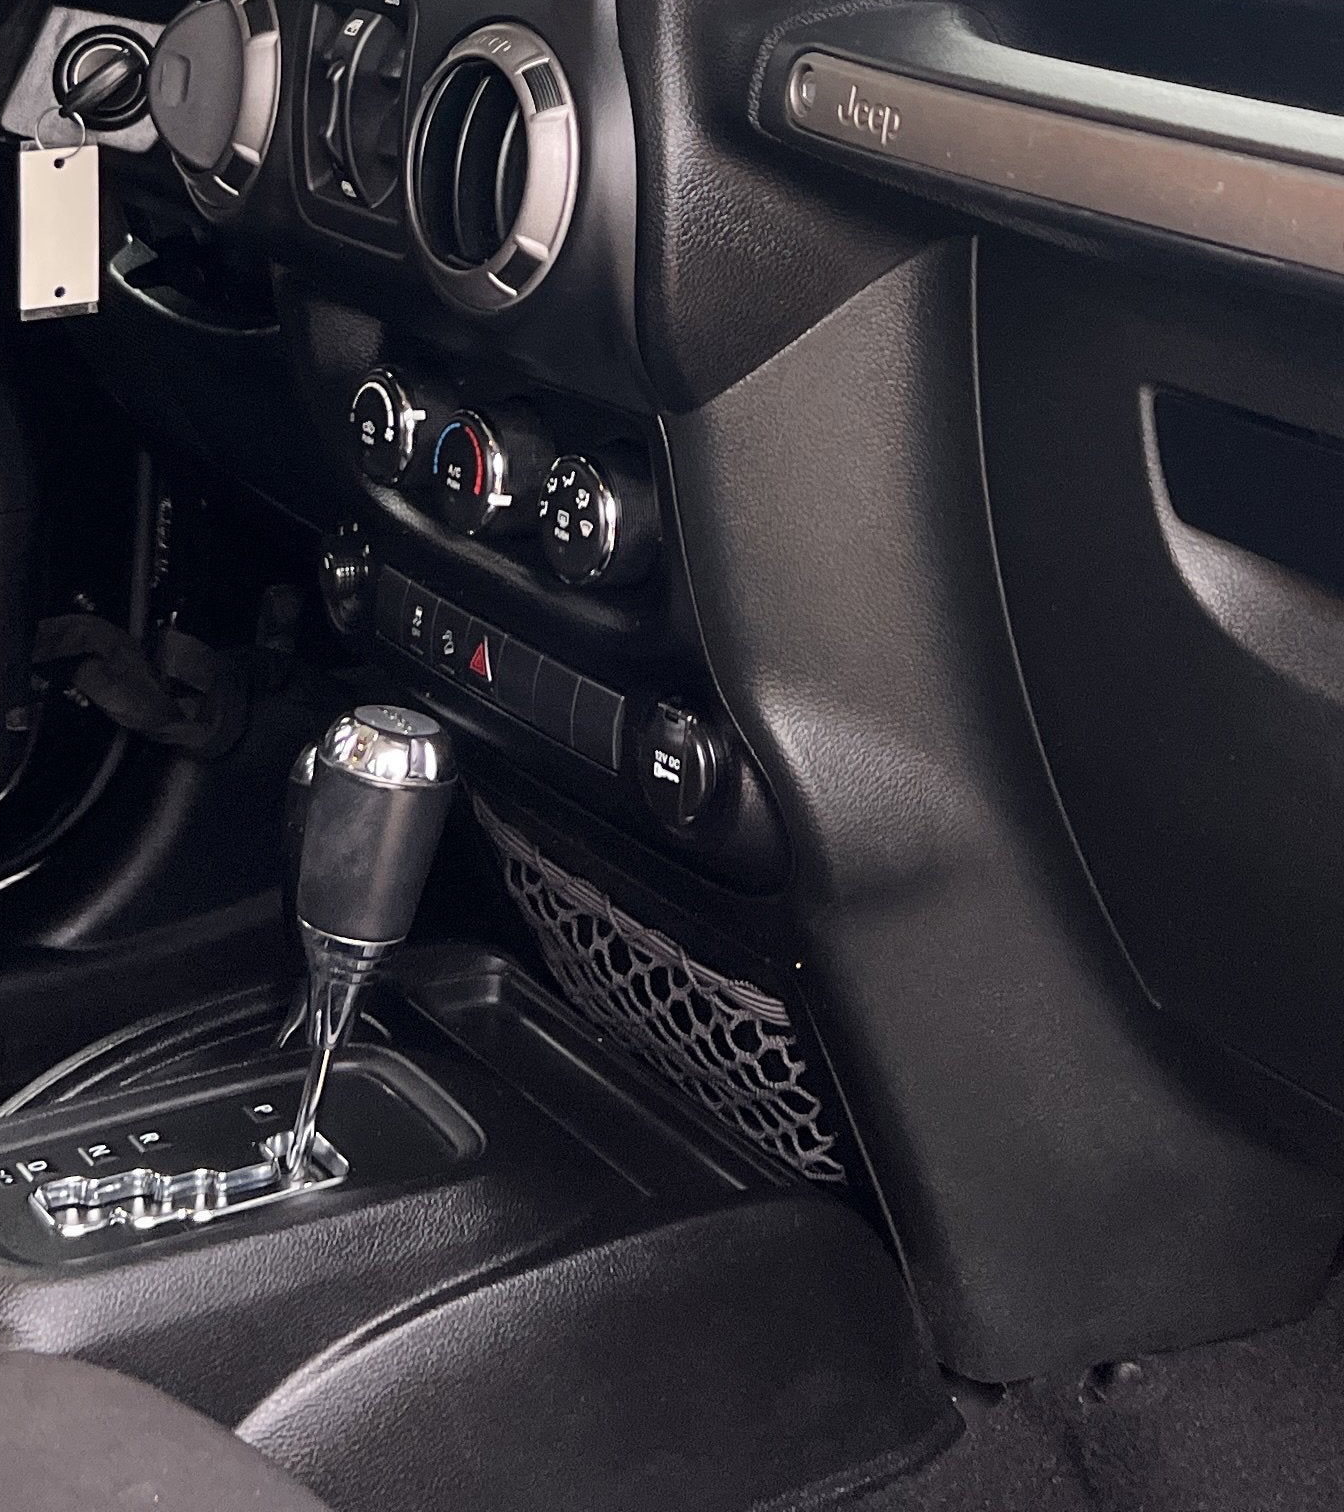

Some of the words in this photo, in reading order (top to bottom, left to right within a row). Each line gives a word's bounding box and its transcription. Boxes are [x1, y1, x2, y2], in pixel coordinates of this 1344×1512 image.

[837, 85, 900, 148] Jeep
[253, 1103, 274, 1115] P
[139, 1131, 160, 1144] R
[88, 1143, 111, 1158] N
